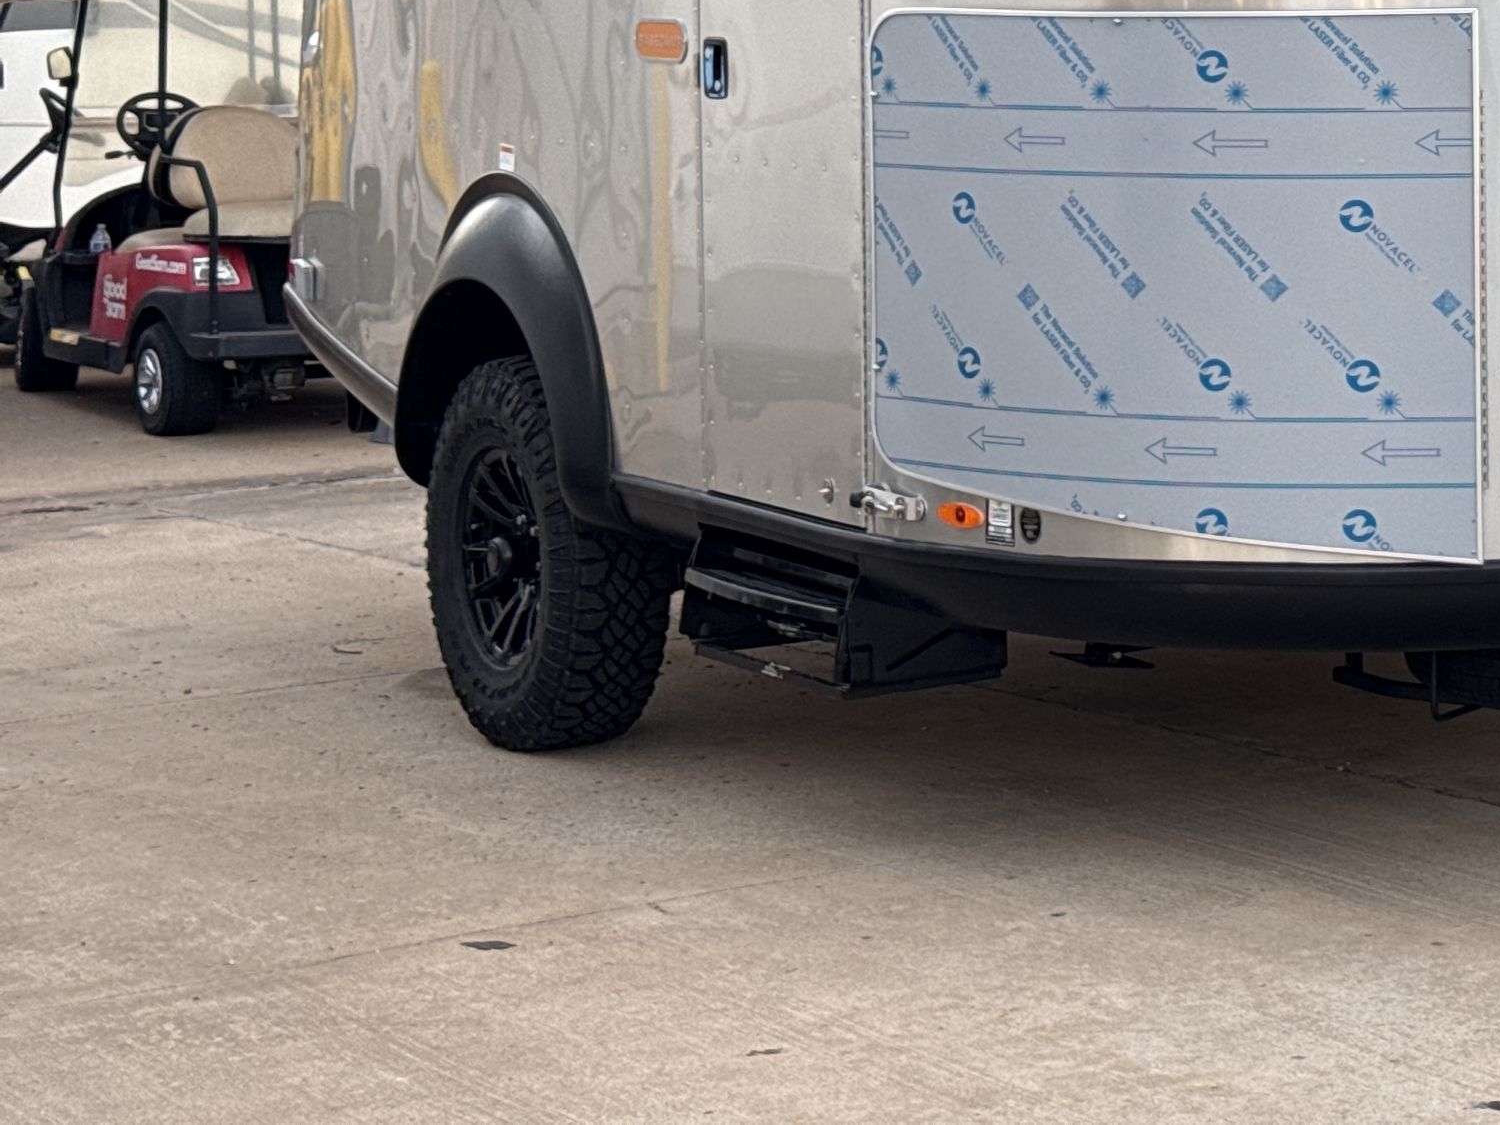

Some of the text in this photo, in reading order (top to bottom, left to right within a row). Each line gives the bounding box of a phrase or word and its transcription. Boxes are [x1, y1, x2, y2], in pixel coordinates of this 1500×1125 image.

[973, 217, 1005, 266] NOVACEL
[1370, 224, 1416, 273] NOVACEL
[1161, 317, 1202, 366] NOVACEL
[1304, 319, 1350, 368] NOVACEL
